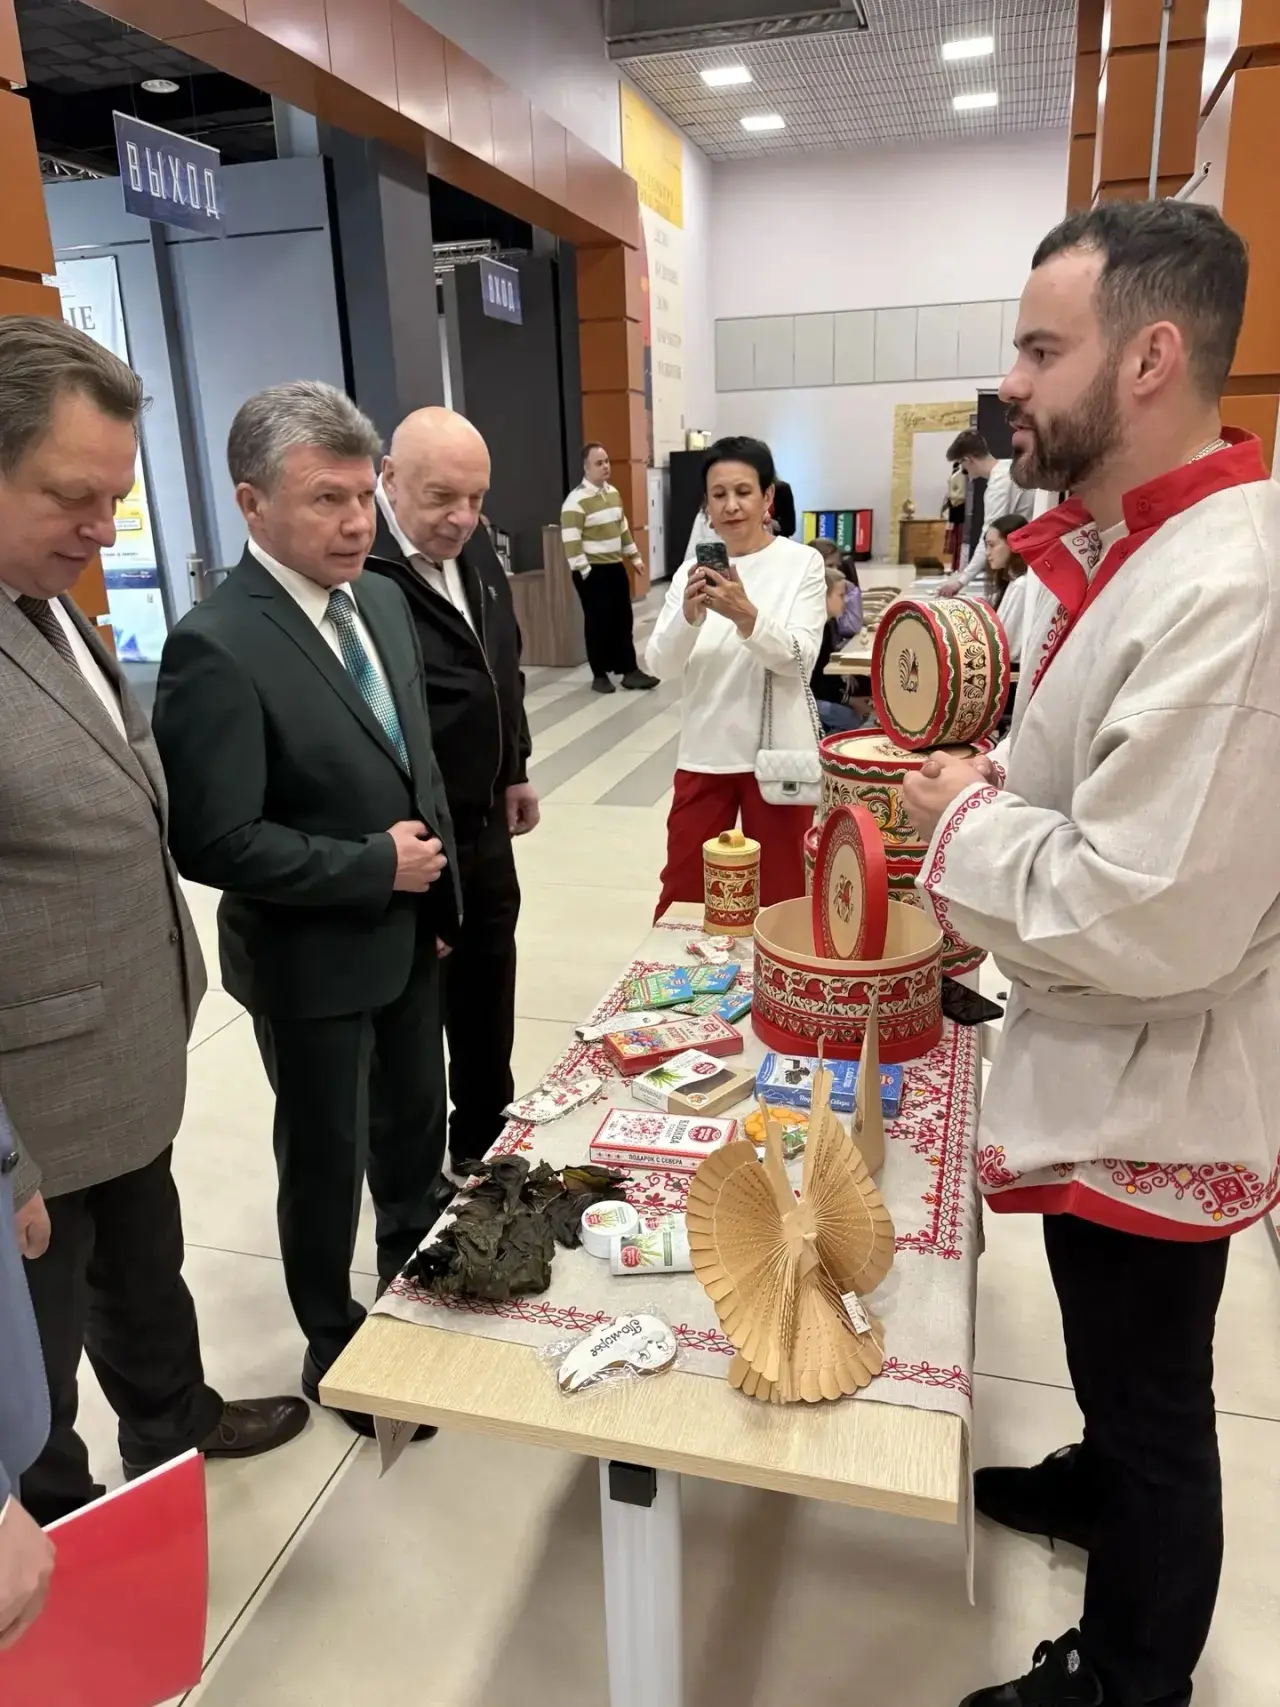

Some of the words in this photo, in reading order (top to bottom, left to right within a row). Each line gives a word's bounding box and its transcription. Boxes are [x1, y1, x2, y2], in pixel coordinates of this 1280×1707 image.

[126, 141, 219, 220] ВЫХОД
[488, 273, 515, 312] ВХОД
[837, 514, 845, 546] БУМАГА
[628, 1154, 655, 1163] ПОДАРОК
[661, 1157, 683, 1165] СЕВЕРА
